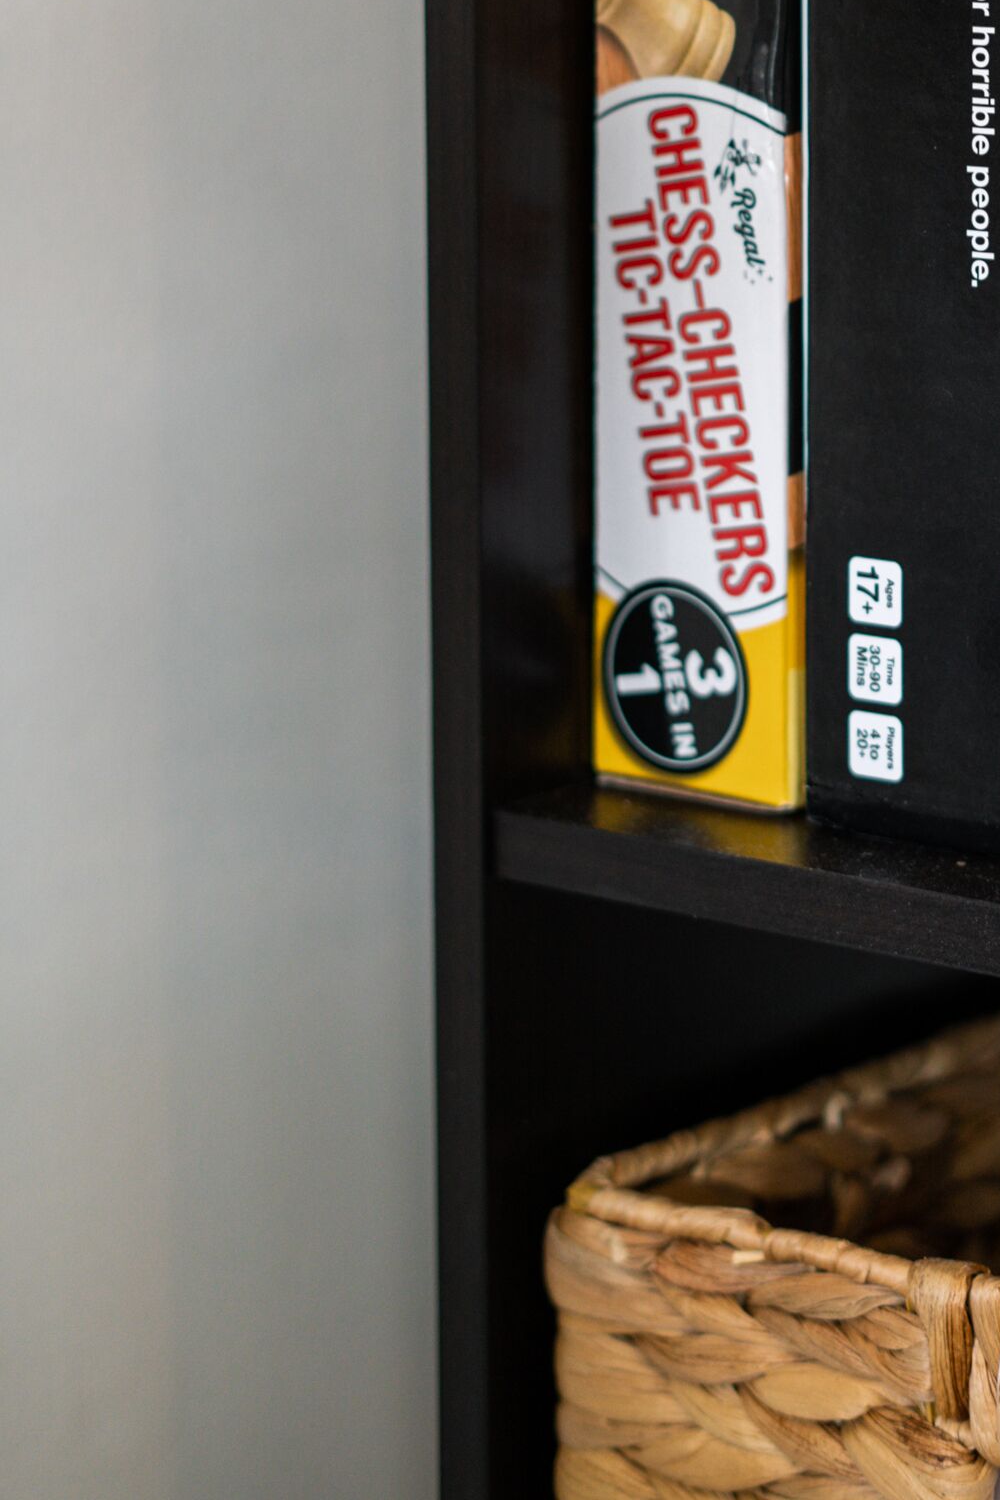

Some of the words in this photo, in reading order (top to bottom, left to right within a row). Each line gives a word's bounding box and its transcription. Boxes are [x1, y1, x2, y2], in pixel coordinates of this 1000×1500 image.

[971, 26, 995, 156] horrible
[730, 188, 765, 268] Regal
[966, 165, 995, 288] people.
[608, 197, 702, 517] TIC-TAC-TOE
[856, 566, 880, 615] 17+
[885, 578, 896, 609] Ages
[650, 594, 692, 715] GAMES
[684, 647, 737, 699] 3
[857, 645, 868, 687] Mins
[869, 645, 881, 693] 30-90
[886, 657, 896, 687] Time
[616, 664, 661, 696] 1
[669, 722, 698, 759] IN
[857, 728, 868, 758] 20+
[870, 729, 881, 740] 4
[870, 743, 881, 761] to
[887, 726, 896, 771] Players
